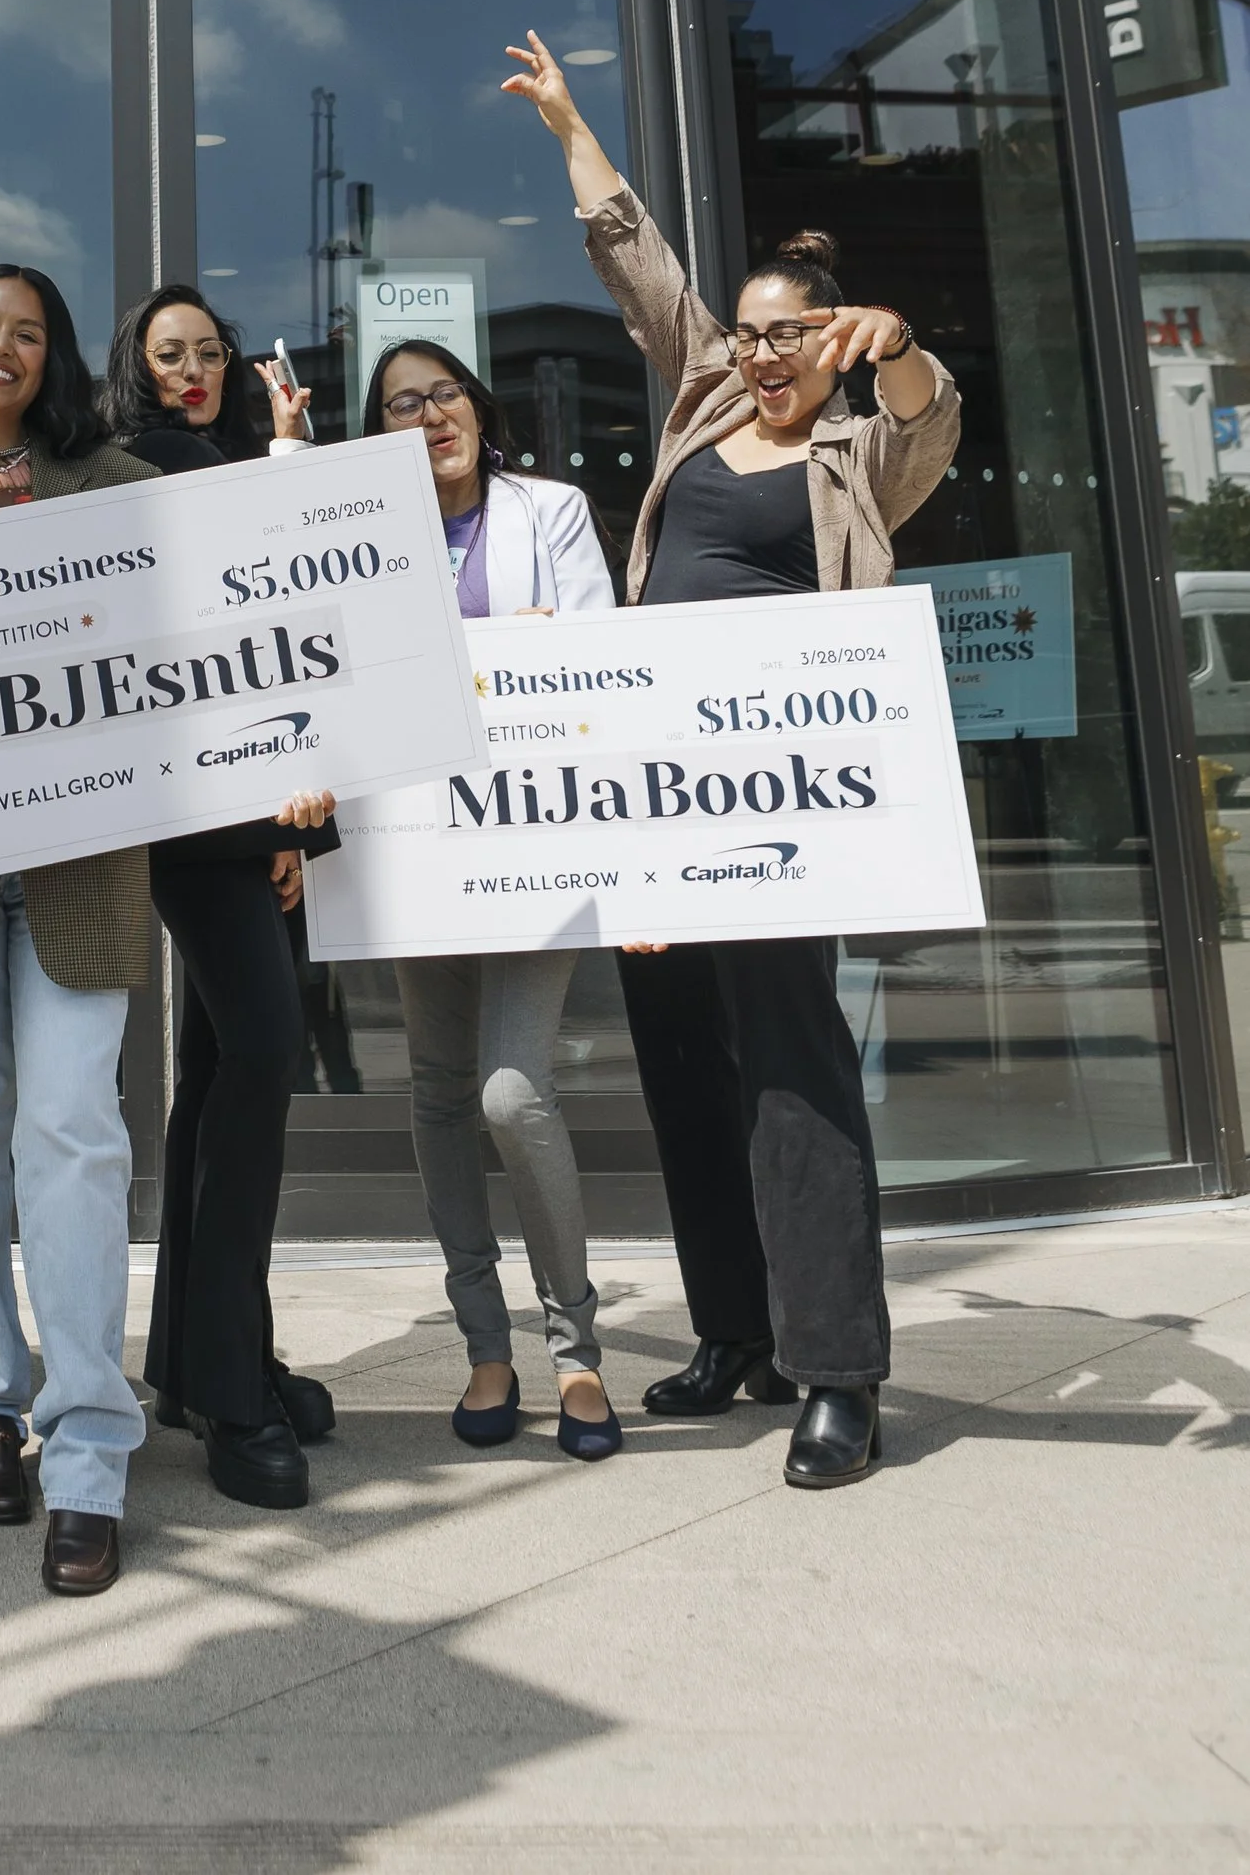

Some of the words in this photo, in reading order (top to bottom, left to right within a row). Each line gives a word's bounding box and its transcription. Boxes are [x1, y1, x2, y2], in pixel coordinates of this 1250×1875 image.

[376, 282, 449, 312] Open
[301, 498, 385, 525] 3/28/2024
[263, 524, 286, 536] DATE
[933, 586, 995, 604] ELCOME
[1001, 585, 1021, 600] TO
[197, 606, 215, 618] USD
[800, 647, 886, 665] 3/28/2024
[943, 639, 1034, 666] siness
[761, 661, 783, 671] DATE
[493, 666, 654, 696] Business
[483, 722, 566, 742] ETITION
[666, 731, 684, 741] USD
[640, 754, 877, 819] Books
[357, 826, 369, 835] TO
[372, 825, 388, 834] THE
[391, 824, 421, 833] ORDER
[424, 822, 436, 831] OF
[463, 872, 619, 895] #WEALLGROW
